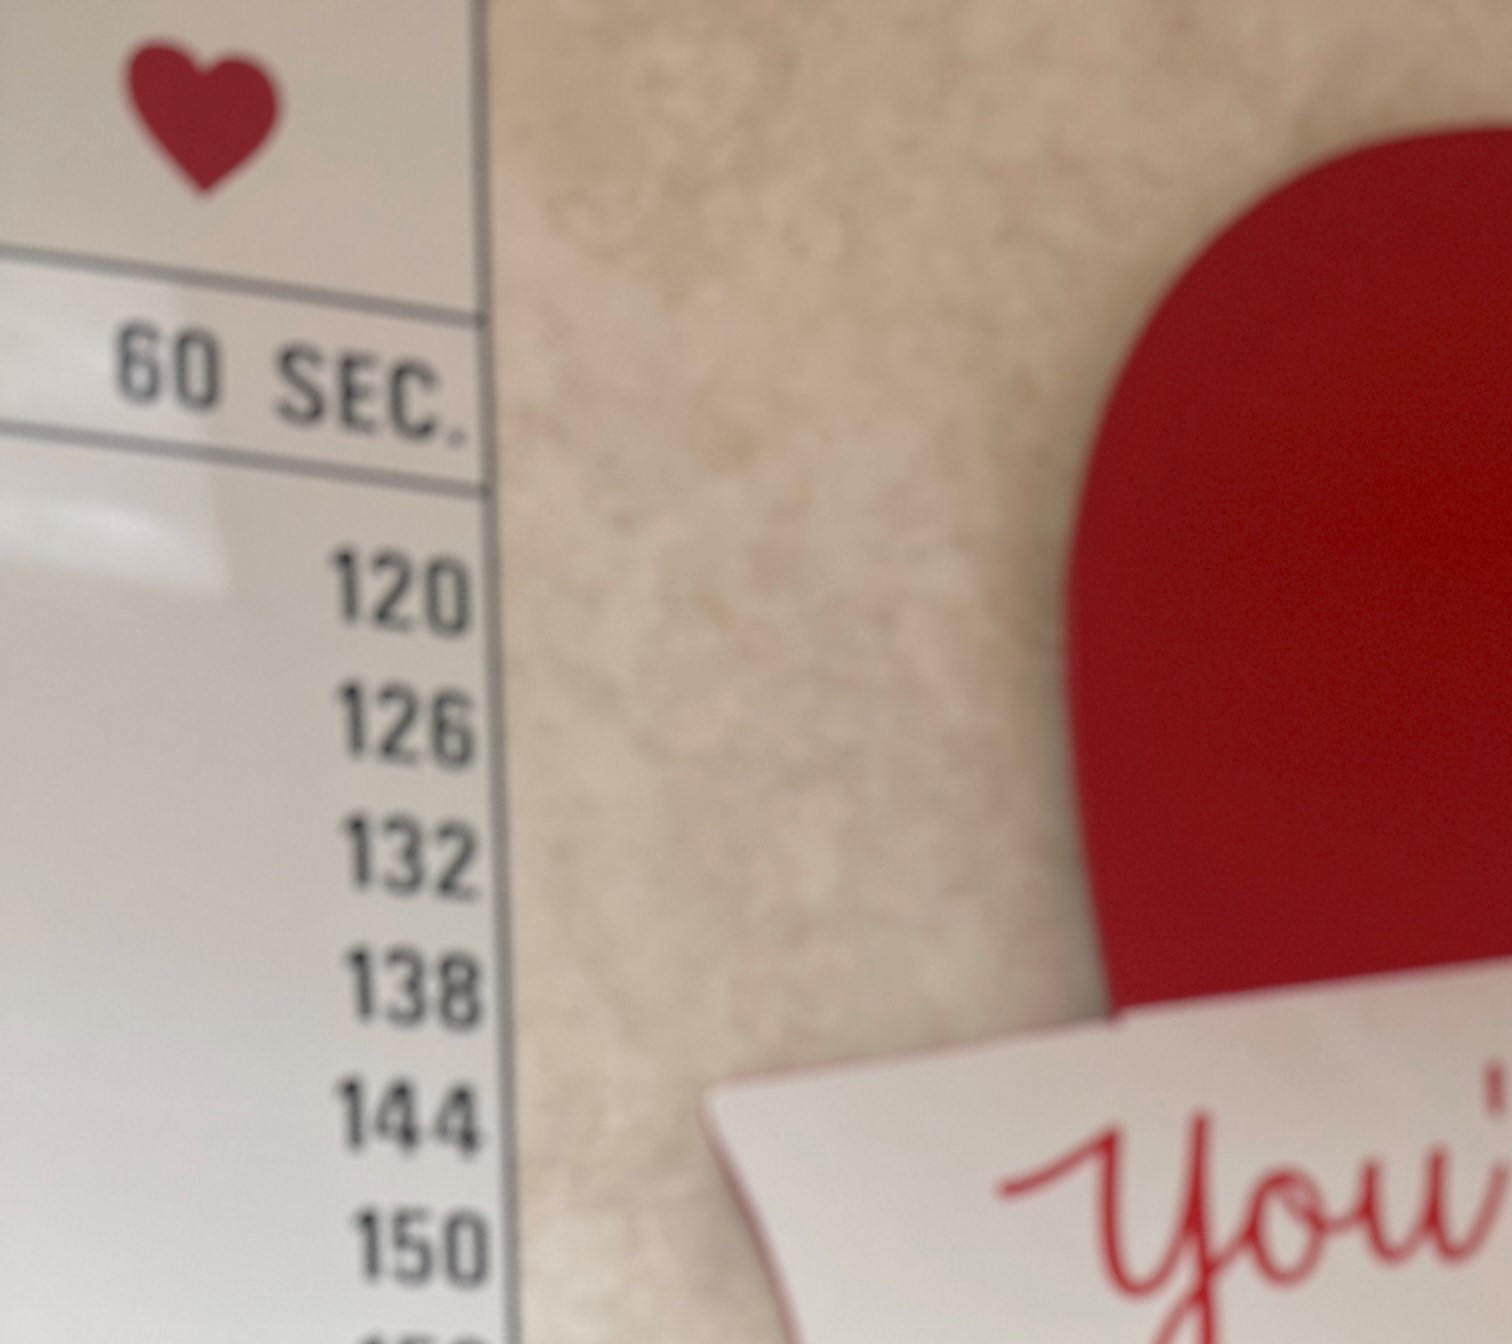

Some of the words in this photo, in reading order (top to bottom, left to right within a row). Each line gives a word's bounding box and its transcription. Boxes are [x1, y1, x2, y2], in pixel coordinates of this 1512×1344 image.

[115, 320, 226, 415] 60
[274, 342, 467, 448] SEC.
[328, 545, 474, 640] 120
[335, 678, 479, 773] 126
[340, 809, 480, 904] 132
[343, 942, 486, 1034] 138
[335, 1073, 484, 1160] 144
[351, 1203, 493, 1291] 150
